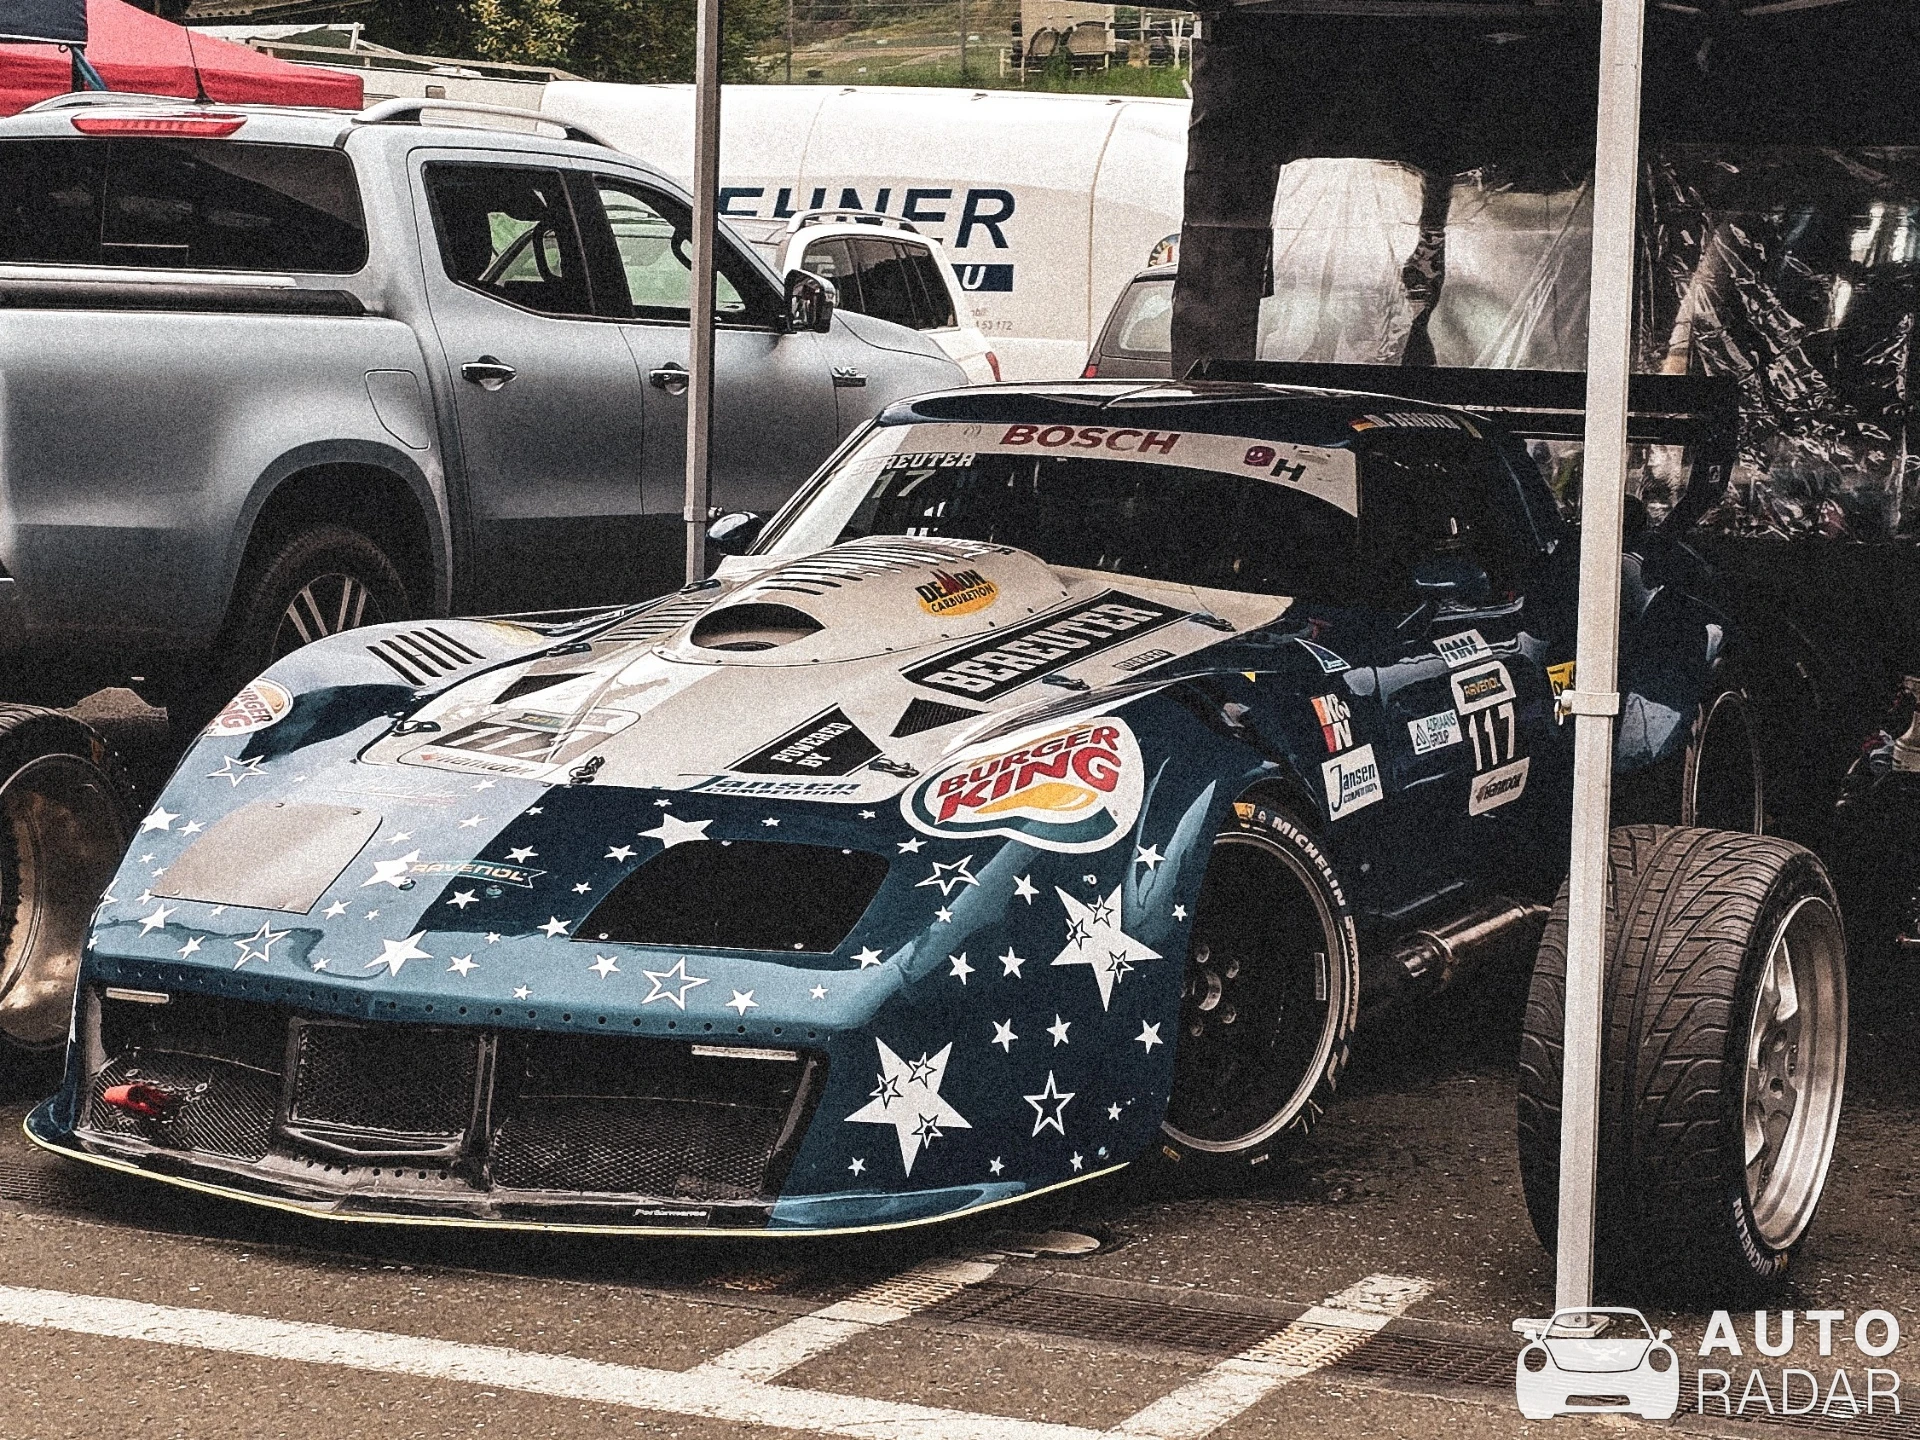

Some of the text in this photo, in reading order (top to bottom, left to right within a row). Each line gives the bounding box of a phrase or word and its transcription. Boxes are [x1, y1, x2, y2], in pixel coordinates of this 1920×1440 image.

[1000, 424, 1181, 454] BOSCH
[915, 569, 987, 603] DEMON
[931, 584, 994, 612] CARBURETION
[922, 603, 1164, 693] BEREUTER
[770, 722, 853, 763] POWERED
[796, 752, 832, 768] BY
[1468, 701, 1515, 771] 117
[937, 726, 1120, 798] BURGER
[937, 746, 1122, 823] KING
[1329, 763, 1376, 812] Jansen
[409, 862, 524, 882] RAVENOL
[1271, 817, 1346, 907] MICHELIN
[1733, 1197, 1773, 1276] MICHELIN
